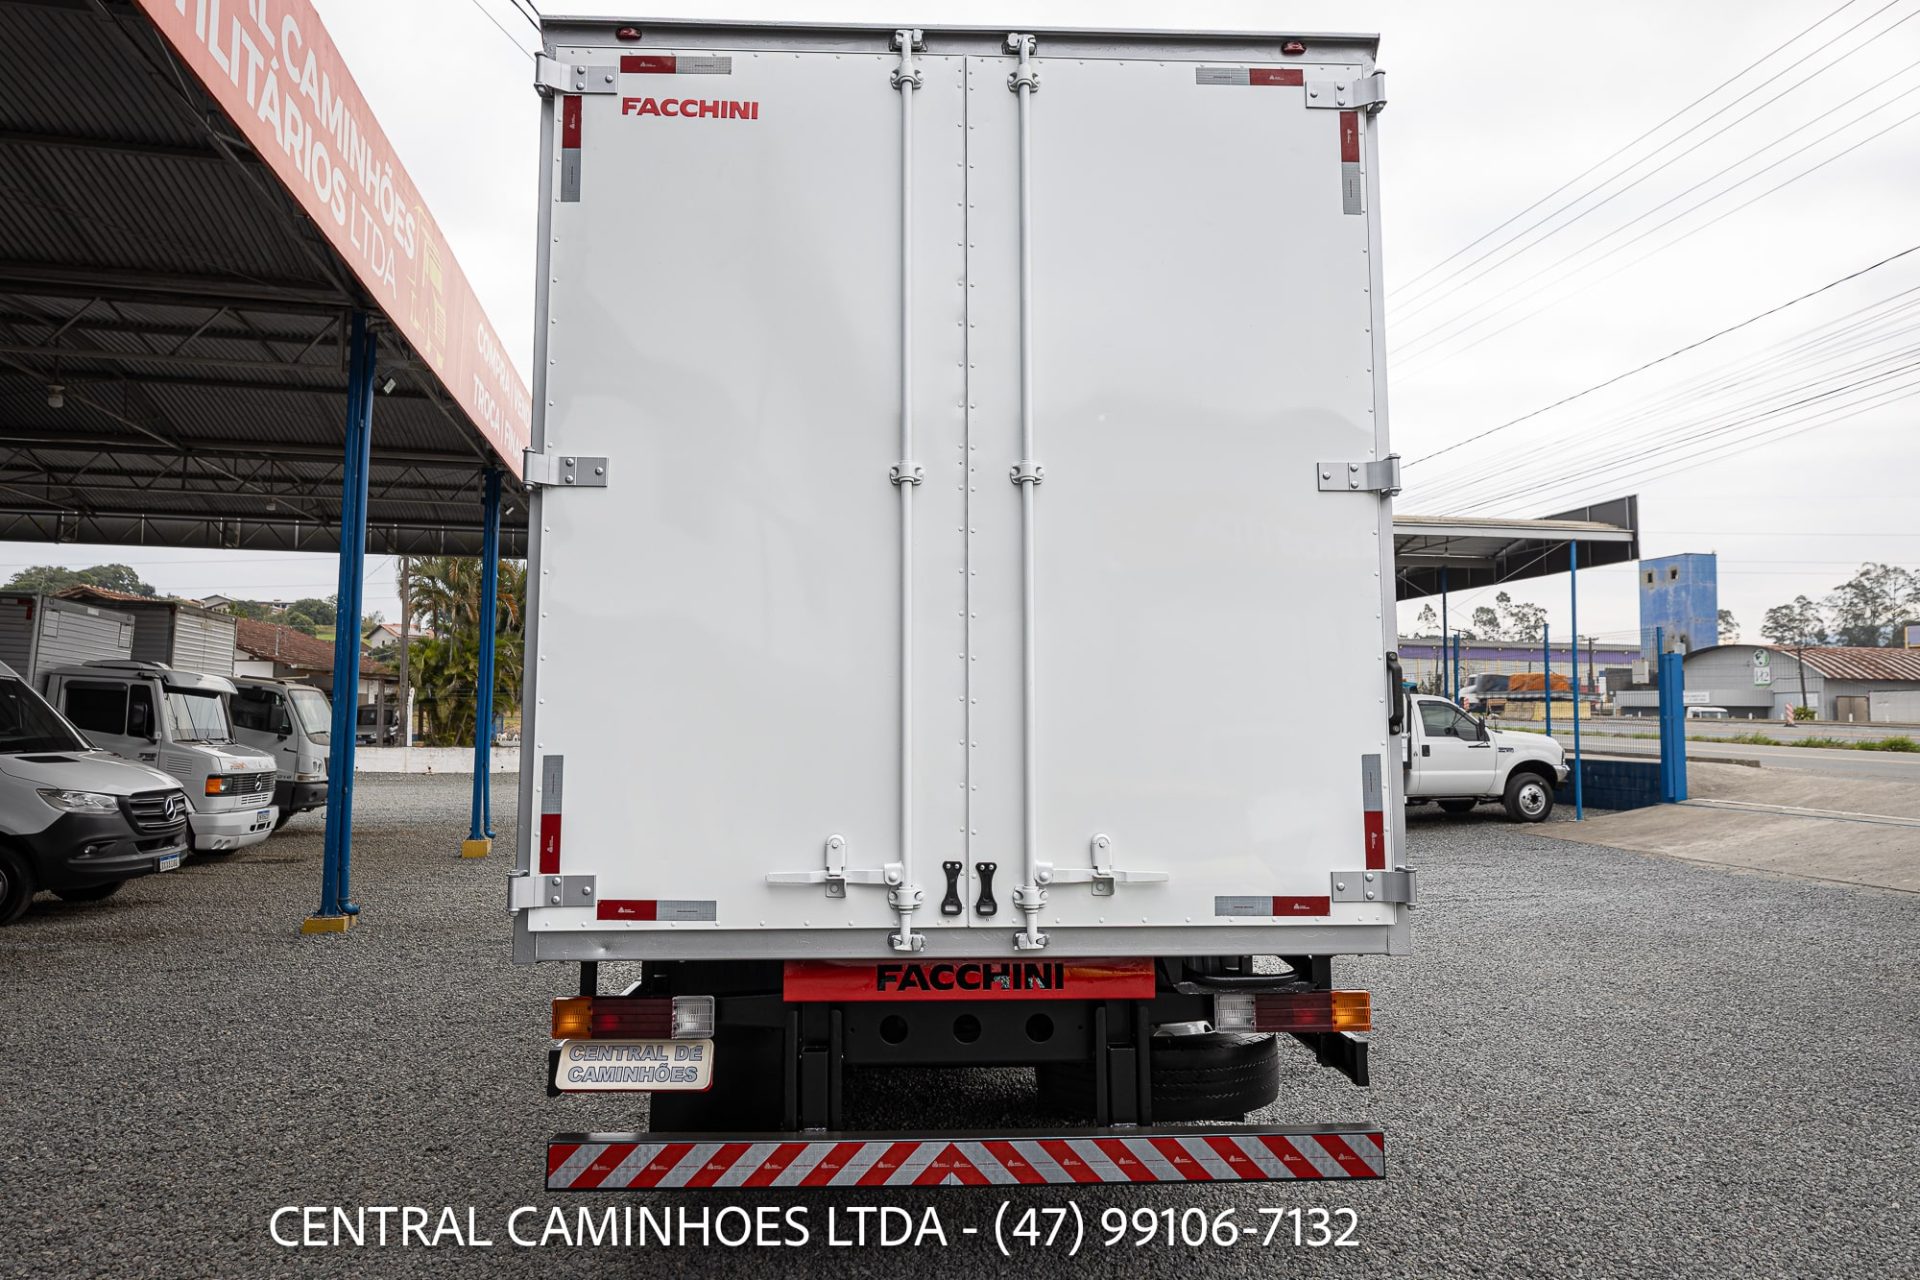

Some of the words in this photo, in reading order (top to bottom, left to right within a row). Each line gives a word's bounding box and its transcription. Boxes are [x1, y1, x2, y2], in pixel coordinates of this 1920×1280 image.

[621, 97, 759, 120] FACCHINI
[175, 0, 347, 226] ILITÁRIOS
[351, 191, 397, 299] LTDA
[477, 322, 510, 397] COMPRA
[473, 373, 500, 436] TROCA
[876, 963, 1065, 991] FACCHINI
[569, 1045, 669, 1061] CENTRAL
[674, 1045, 704, 1061] DE
[568, 1063, 698, 1082] CAMINHÕES
